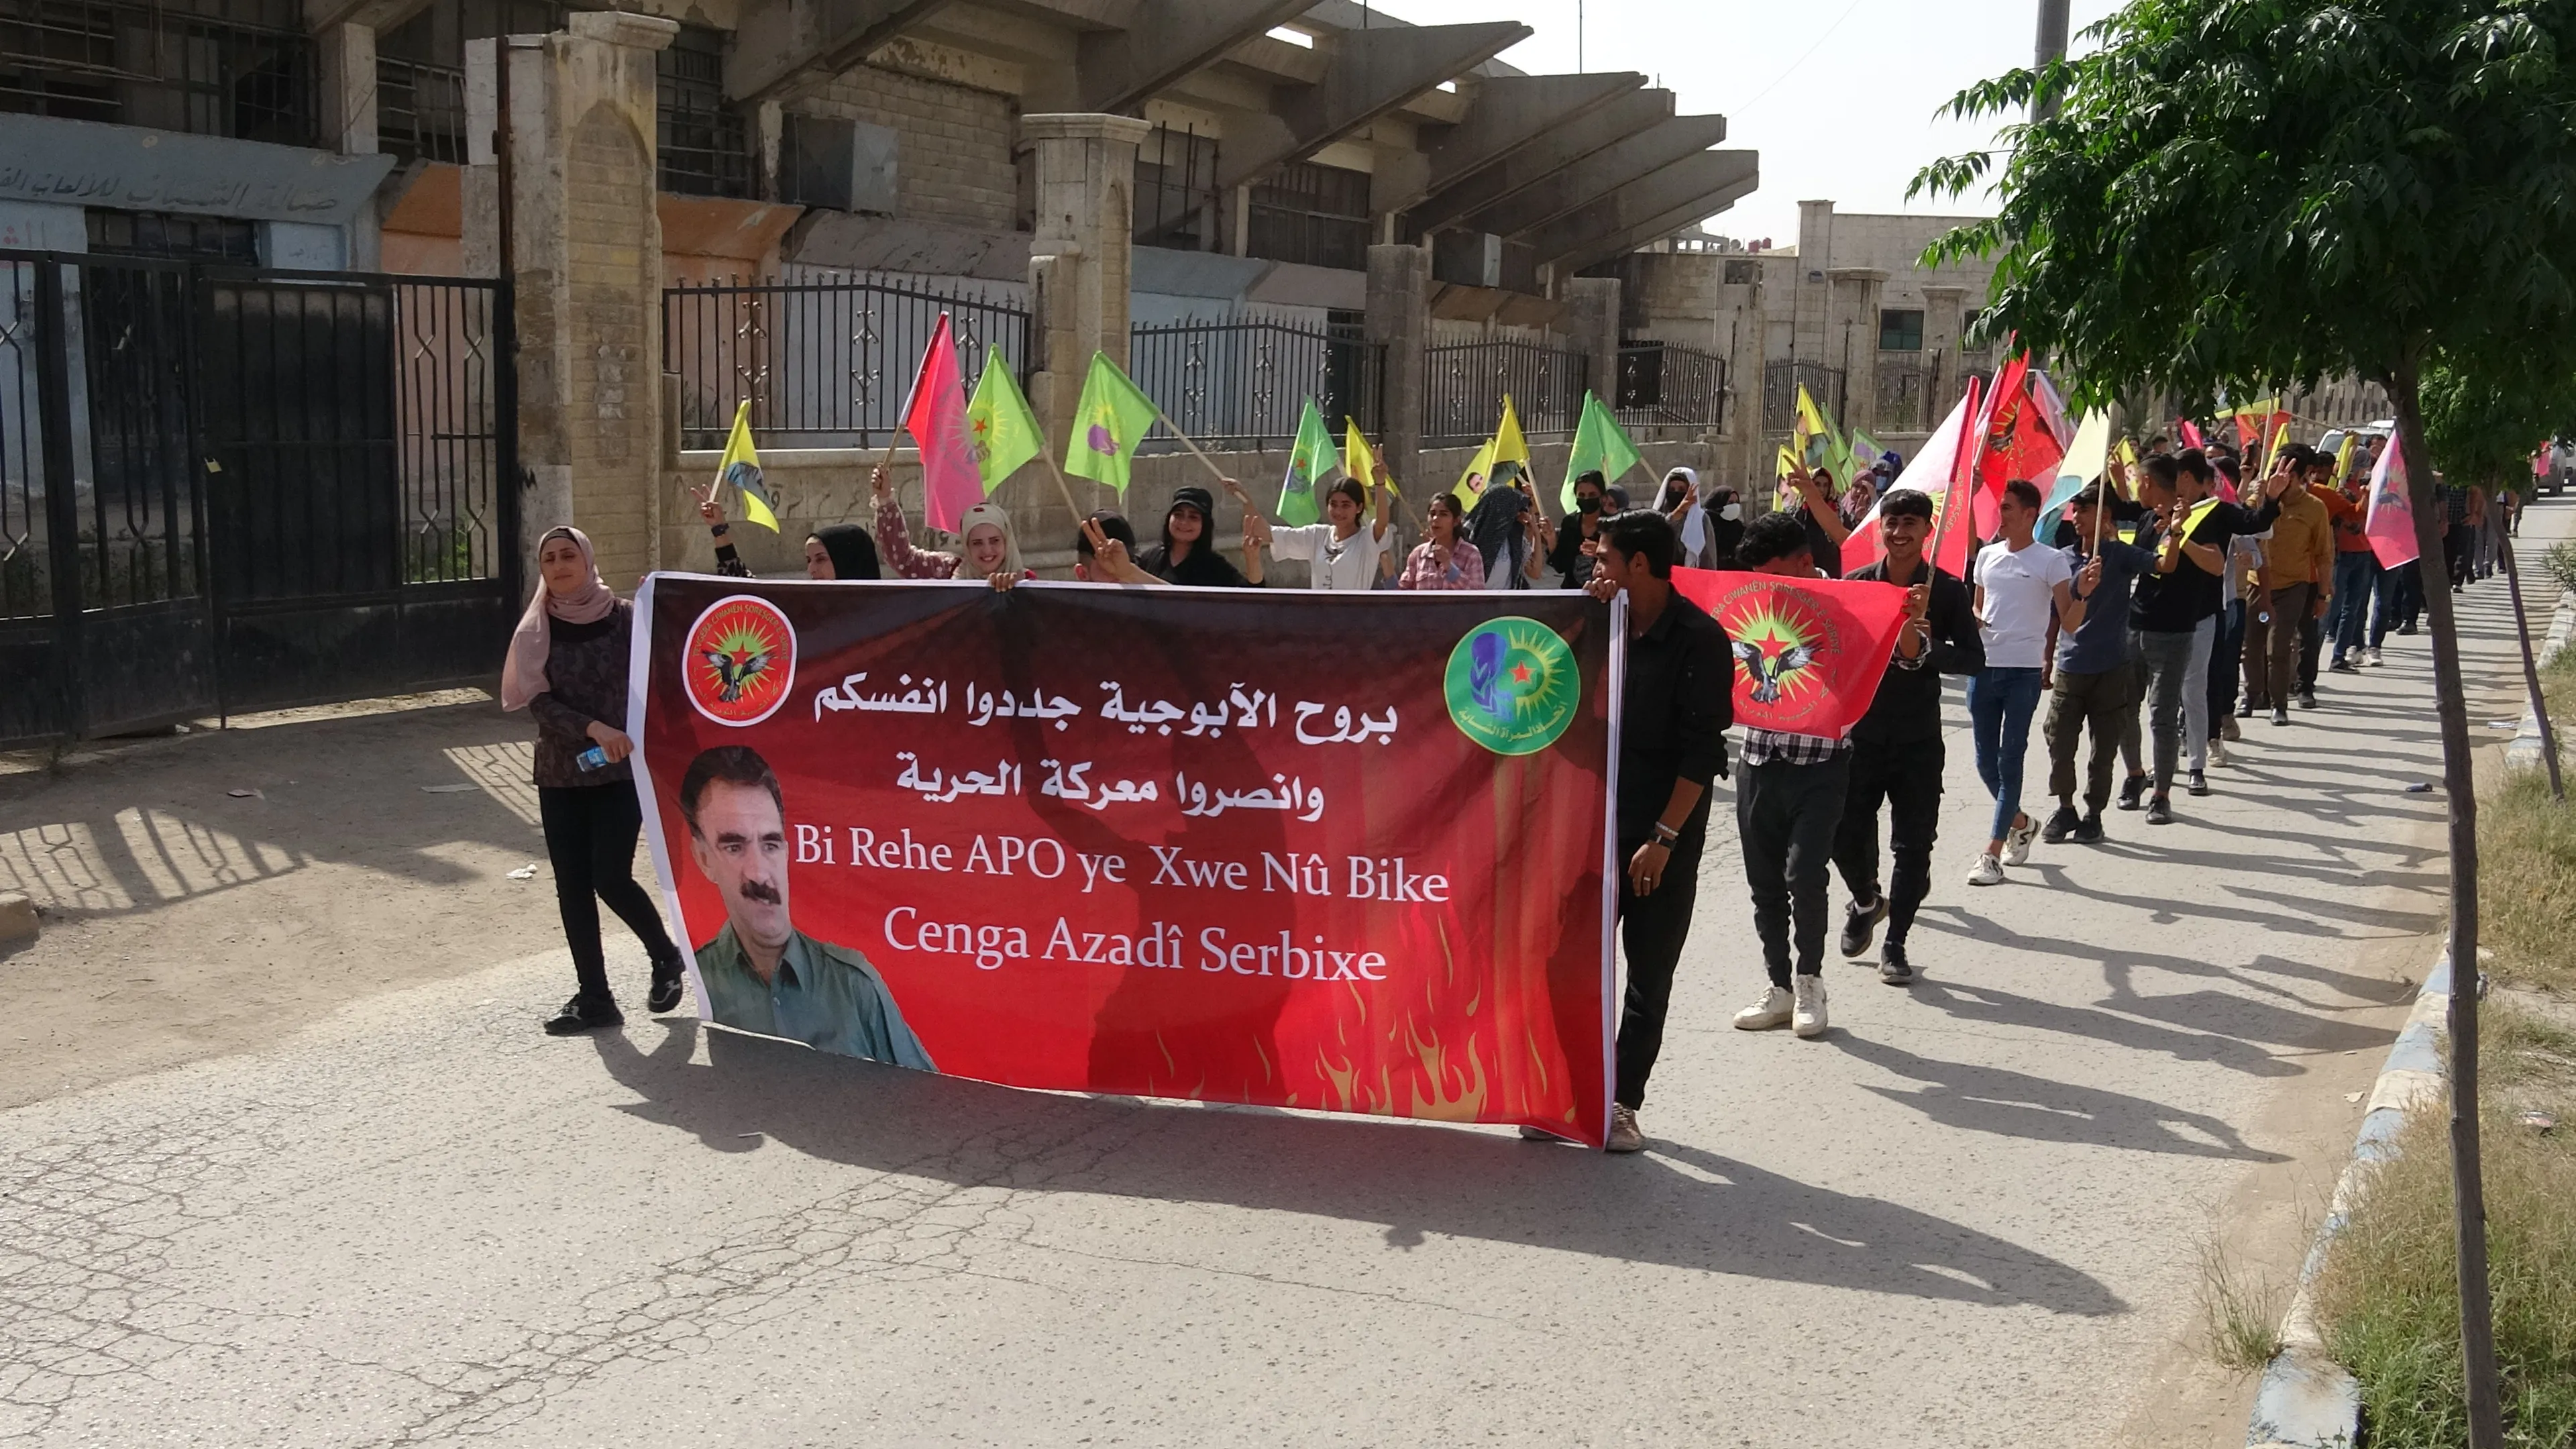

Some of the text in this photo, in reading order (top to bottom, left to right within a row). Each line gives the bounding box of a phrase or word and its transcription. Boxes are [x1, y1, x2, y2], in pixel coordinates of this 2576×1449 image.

[814, 672, 1398, 745] بروح الآبوجية جددوا انفسكم
[896, 751, 1324, 822] وانصروا معركة الحرية
[794, 824, 1449, 902] Bi Rehe APO ye Xwe Nû Bike
[884, 906, 1387, 983] Cenga Azadî Serbixe
